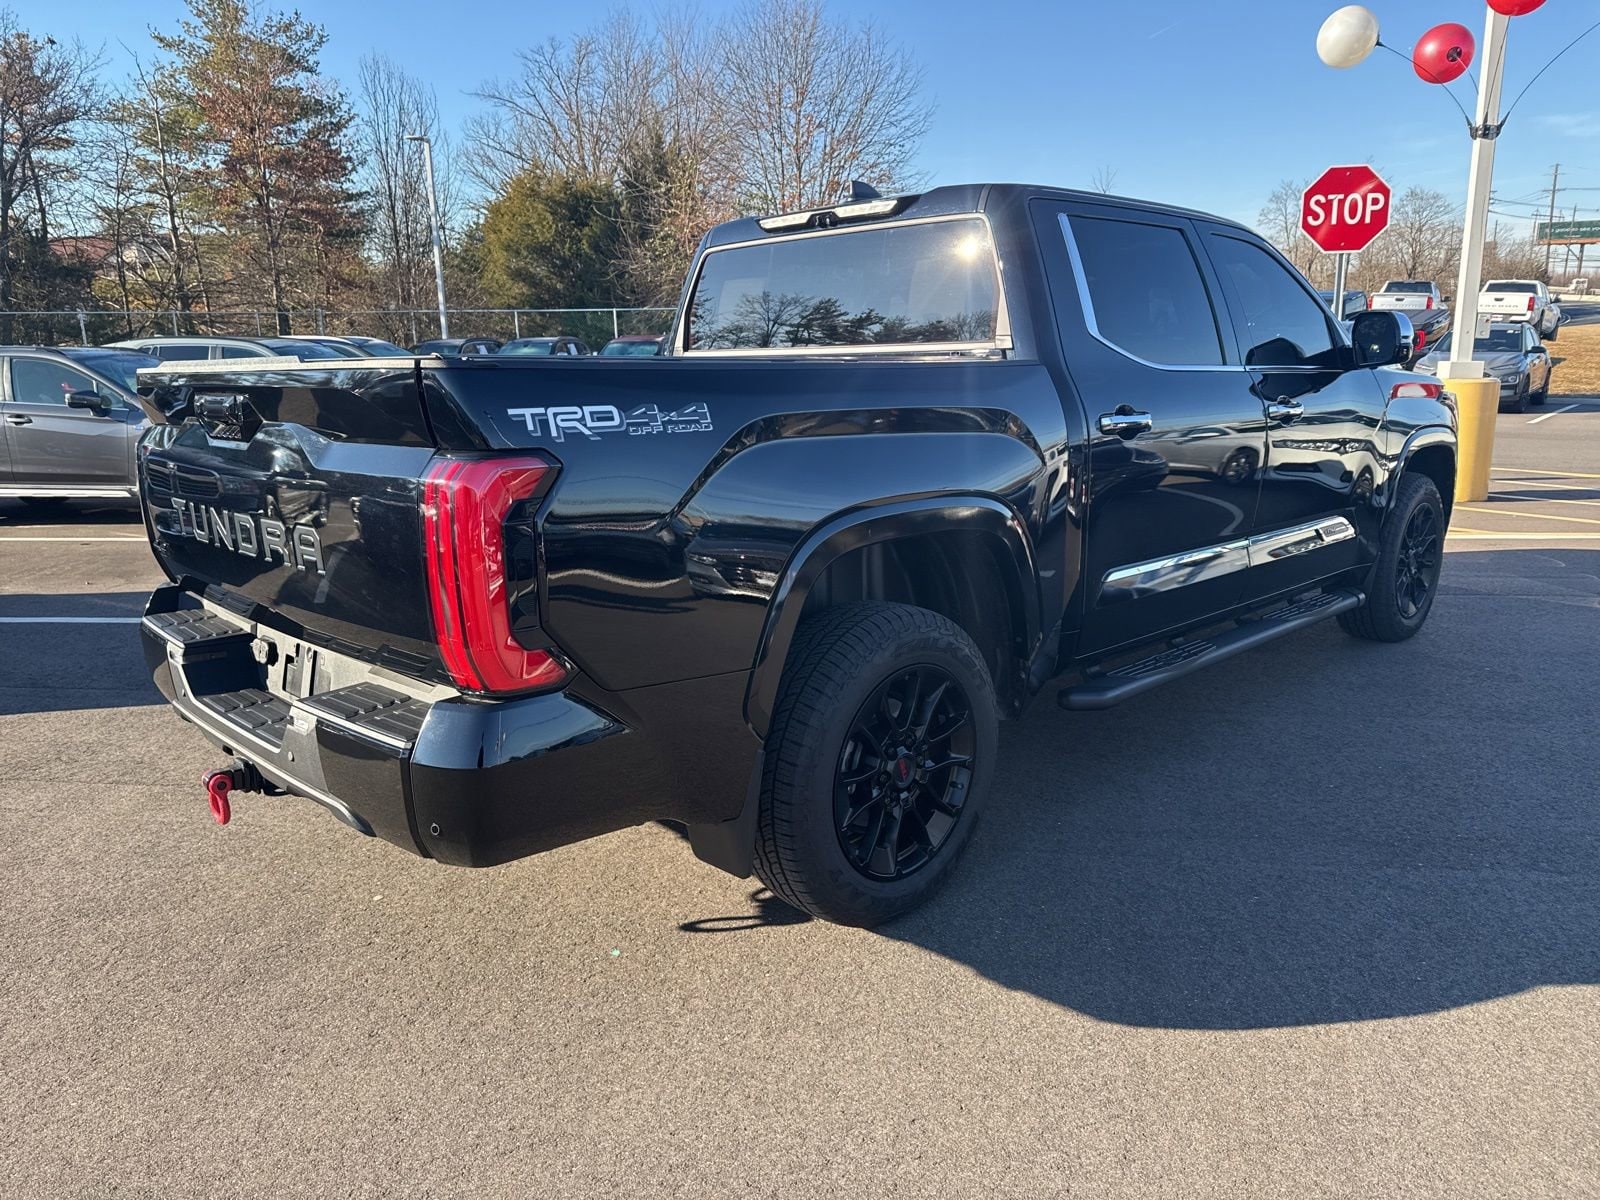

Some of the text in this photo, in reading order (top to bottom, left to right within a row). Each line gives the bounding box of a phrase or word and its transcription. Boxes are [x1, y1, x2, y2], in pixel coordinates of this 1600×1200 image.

[1307, 192, 1385, 227] STOP
[507, 405, 626, 442] TRD
[629, 423, 713, 435] OFF ROAD
[171, 497, 326, 576] TUNDRA
